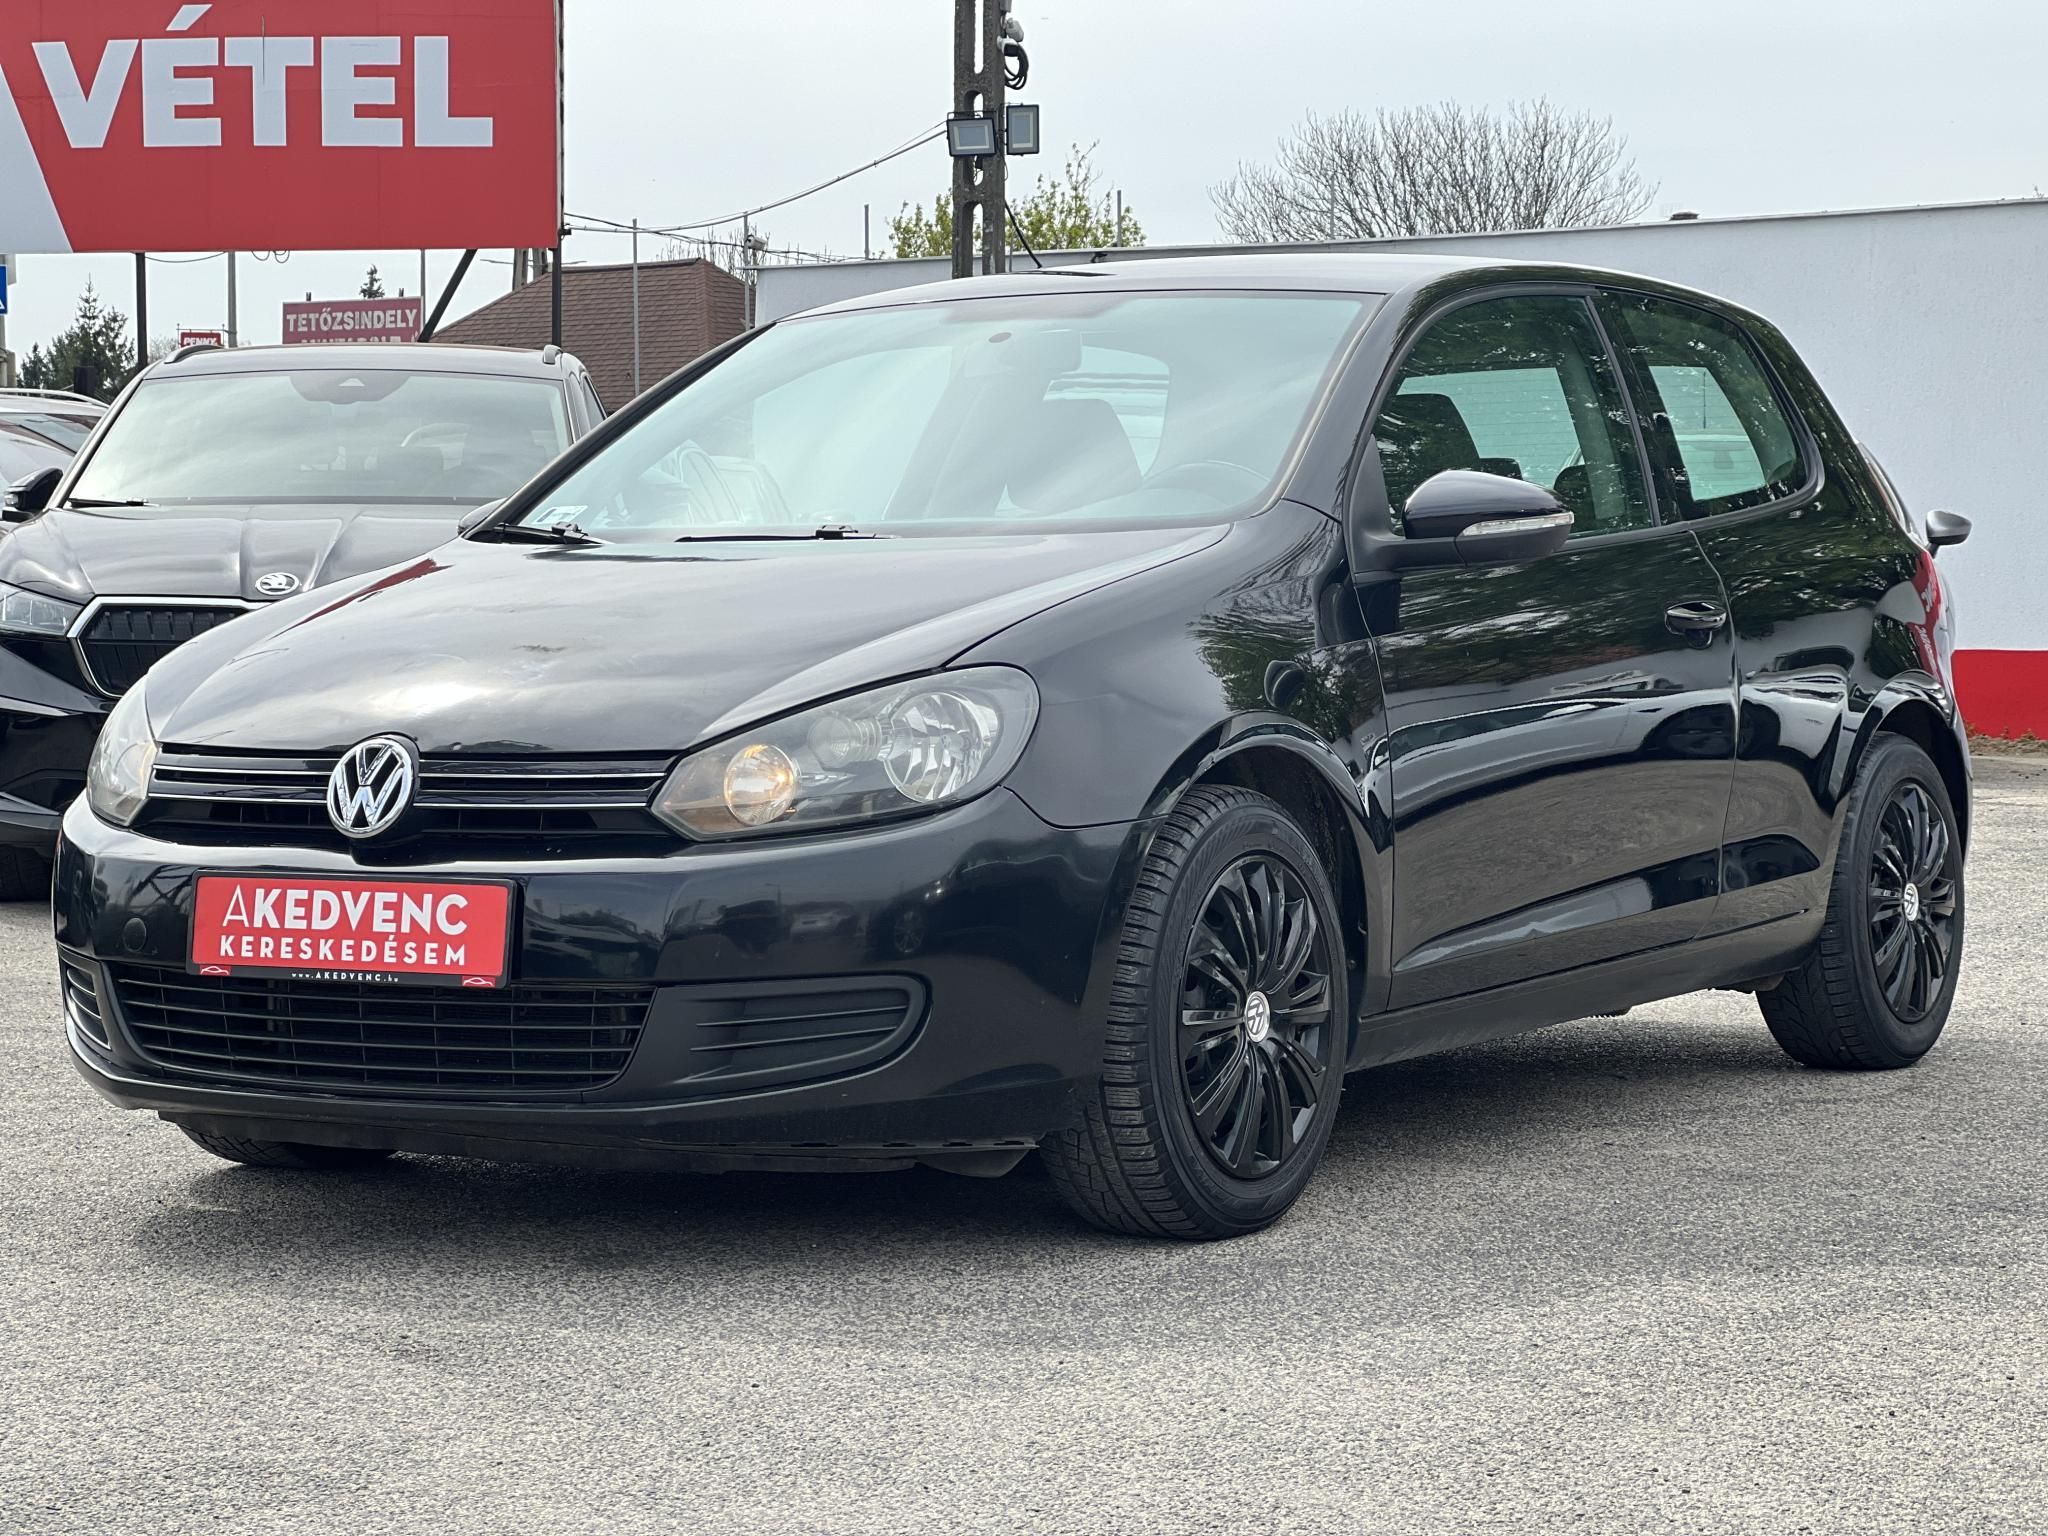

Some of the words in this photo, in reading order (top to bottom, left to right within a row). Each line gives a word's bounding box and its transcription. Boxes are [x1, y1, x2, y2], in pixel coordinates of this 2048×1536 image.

[32, 4, 494, 148] VÉTEL
[286, 307, 417, 332] TETŐZSINDELY
[222, 884, 469, 935] AKEDVENC
[220, 935, 465, 966] KERESKEDÉSEM
